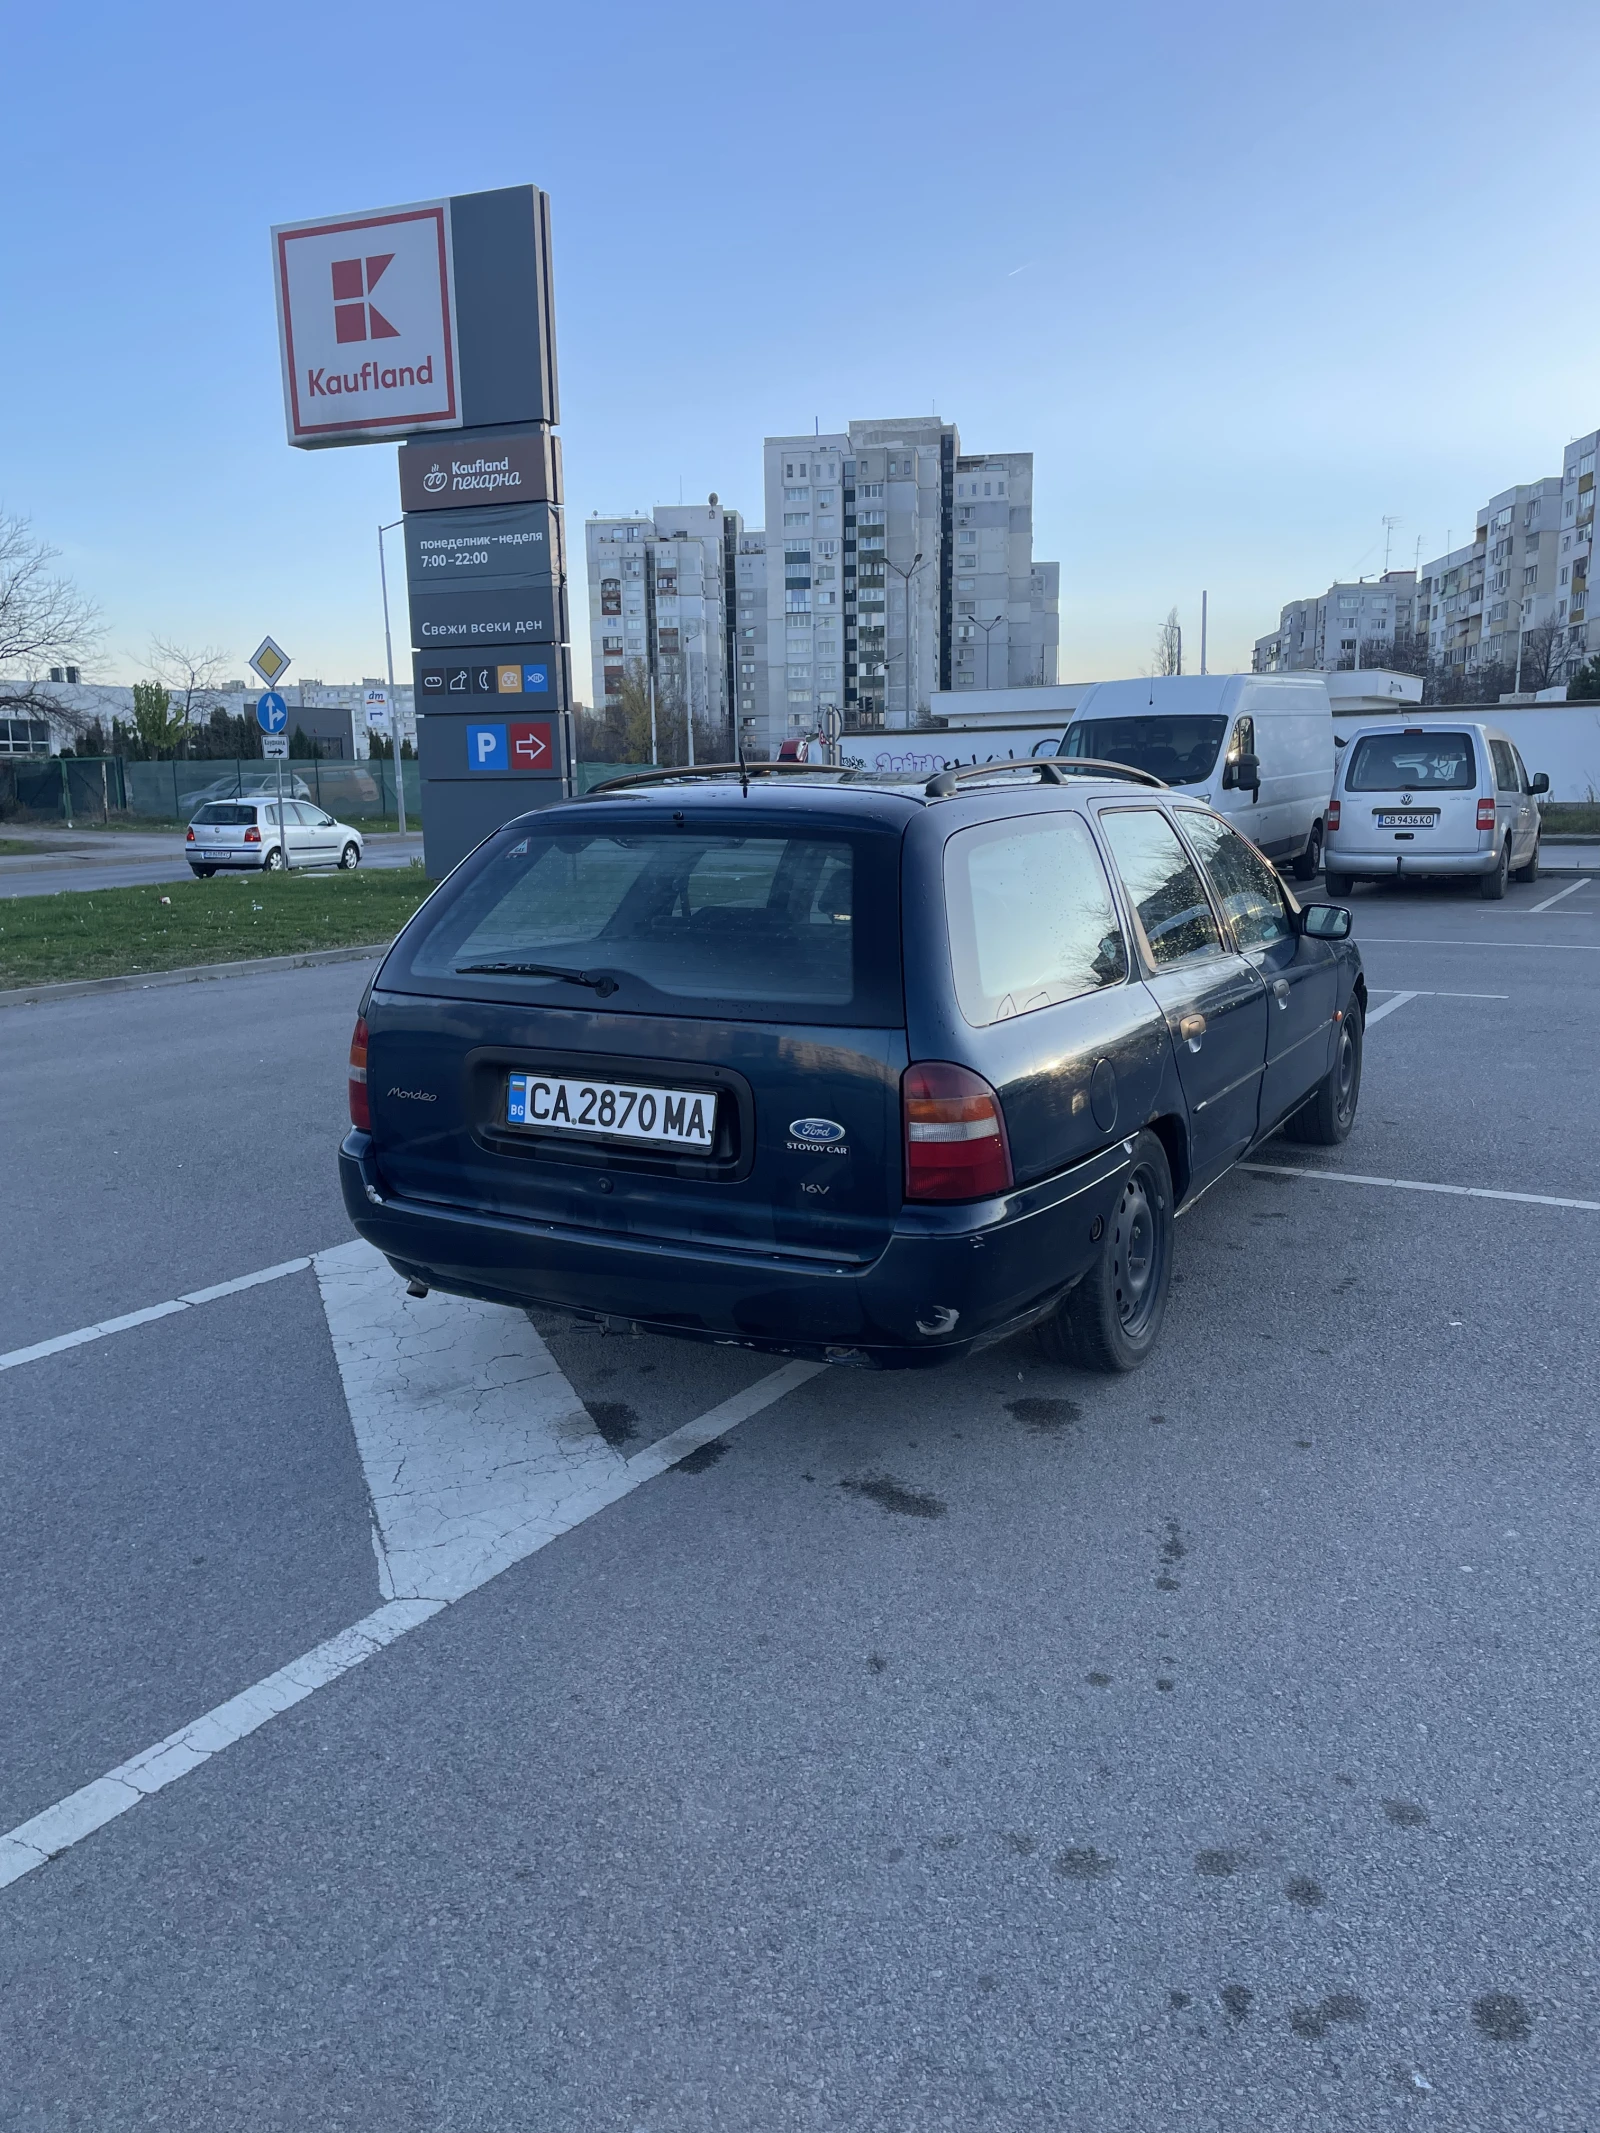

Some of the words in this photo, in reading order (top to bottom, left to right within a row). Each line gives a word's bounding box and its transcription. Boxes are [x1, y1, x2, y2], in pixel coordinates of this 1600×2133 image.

[308, 355, 433, 397] Kaufland
[451, 457, 509, 474] Kaufland
[452, 472, 522, 491] пекарна
[421, 622, 467, 636] Свежи
[470, 622, 511, 633] всеки
[515, 620, 542, 634] ден
[368, 691, 383, 700] dm
[477, 732, 496, 762] P
[1397, 816, 1419, 824] 9436
[387, 1087, 437, 1102] Mondeo
[510, 1104, 524, 1116] BG
[578, 1087, 657, 1132] 2870
[801, 1122, 831, 1136] Ford
[786, 1142, 825, 1152] STOYOV
[826, 1146, 847, 1154] CAR
[800, 1182, 830, 1195] 16V
